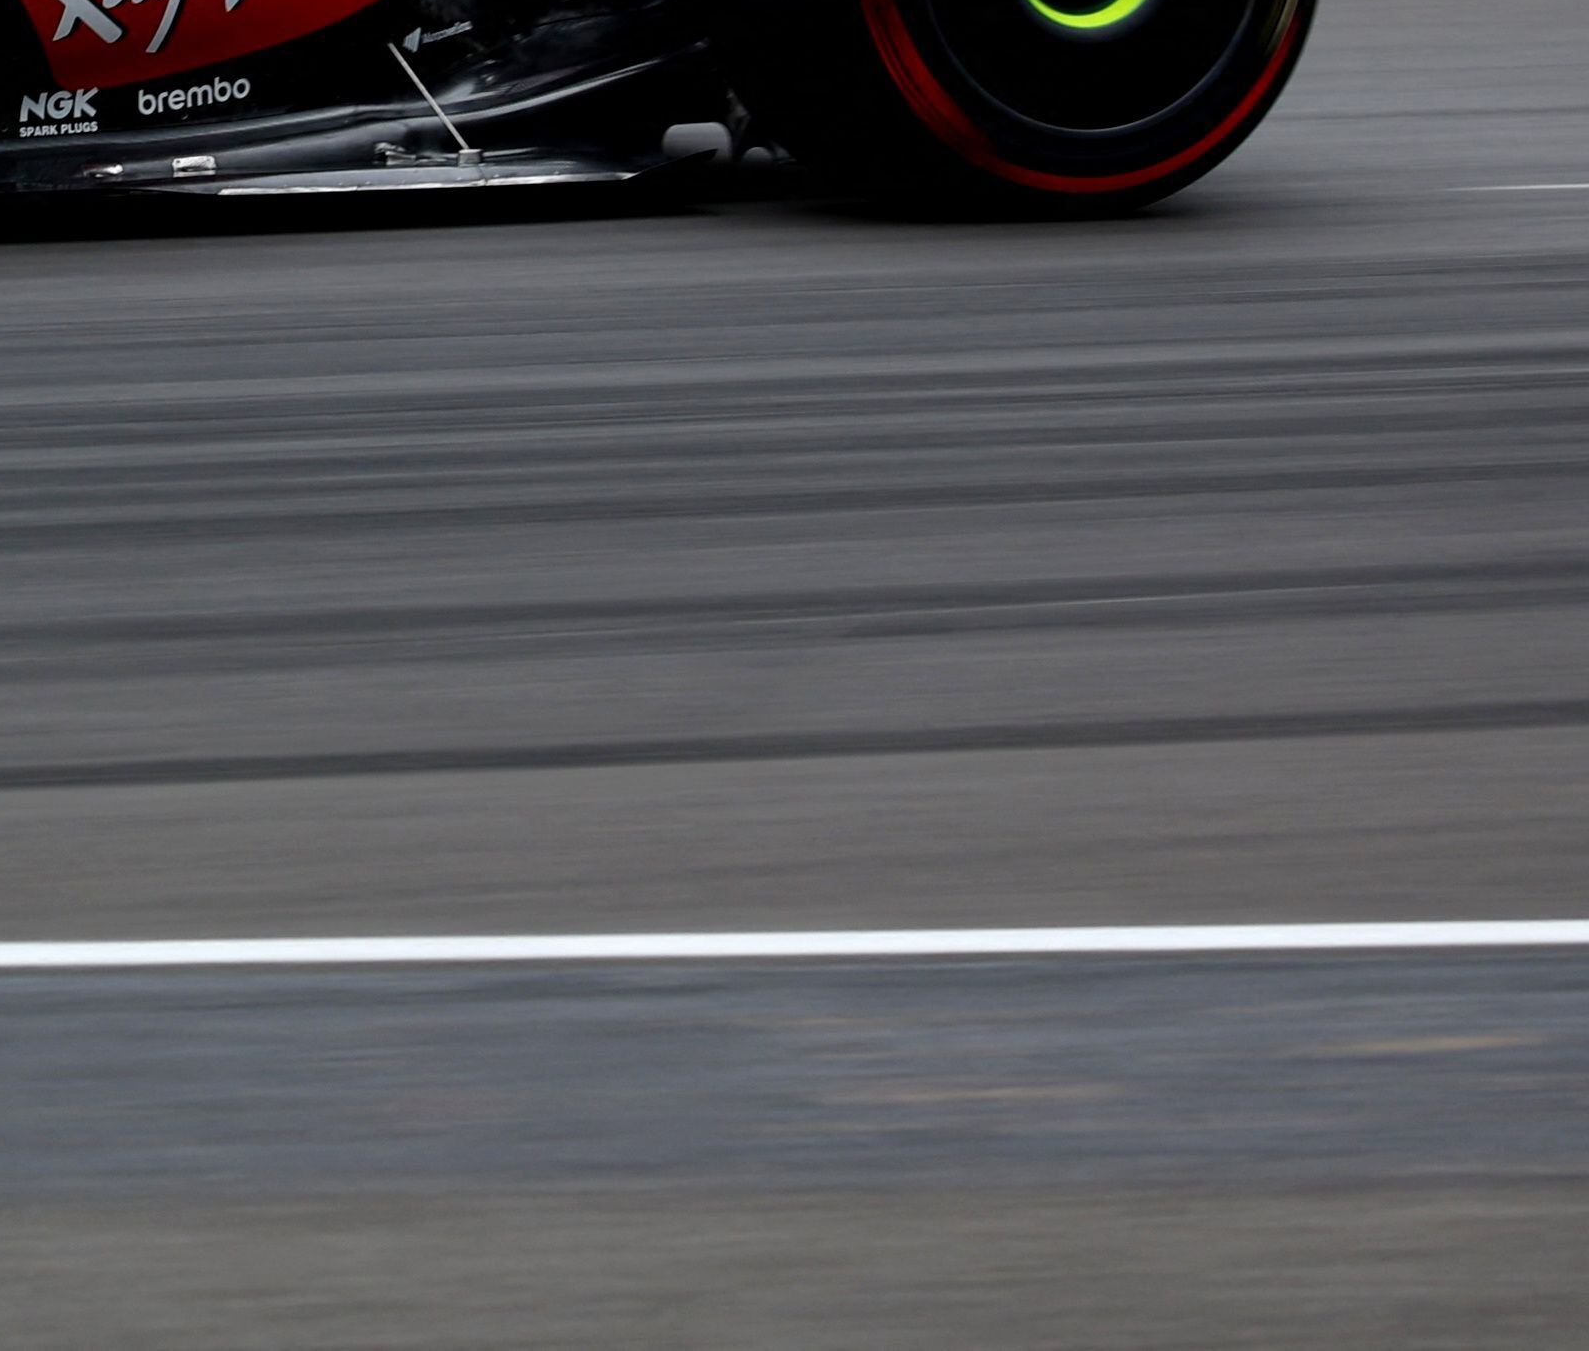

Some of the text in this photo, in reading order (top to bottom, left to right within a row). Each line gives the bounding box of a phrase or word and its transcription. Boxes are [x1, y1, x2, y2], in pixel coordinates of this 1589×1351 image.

[18, 86, 100, 122] NGK
[136, 76, 252, 116] brembo
[18, 120, 100, 139] SPARK PLUGS
